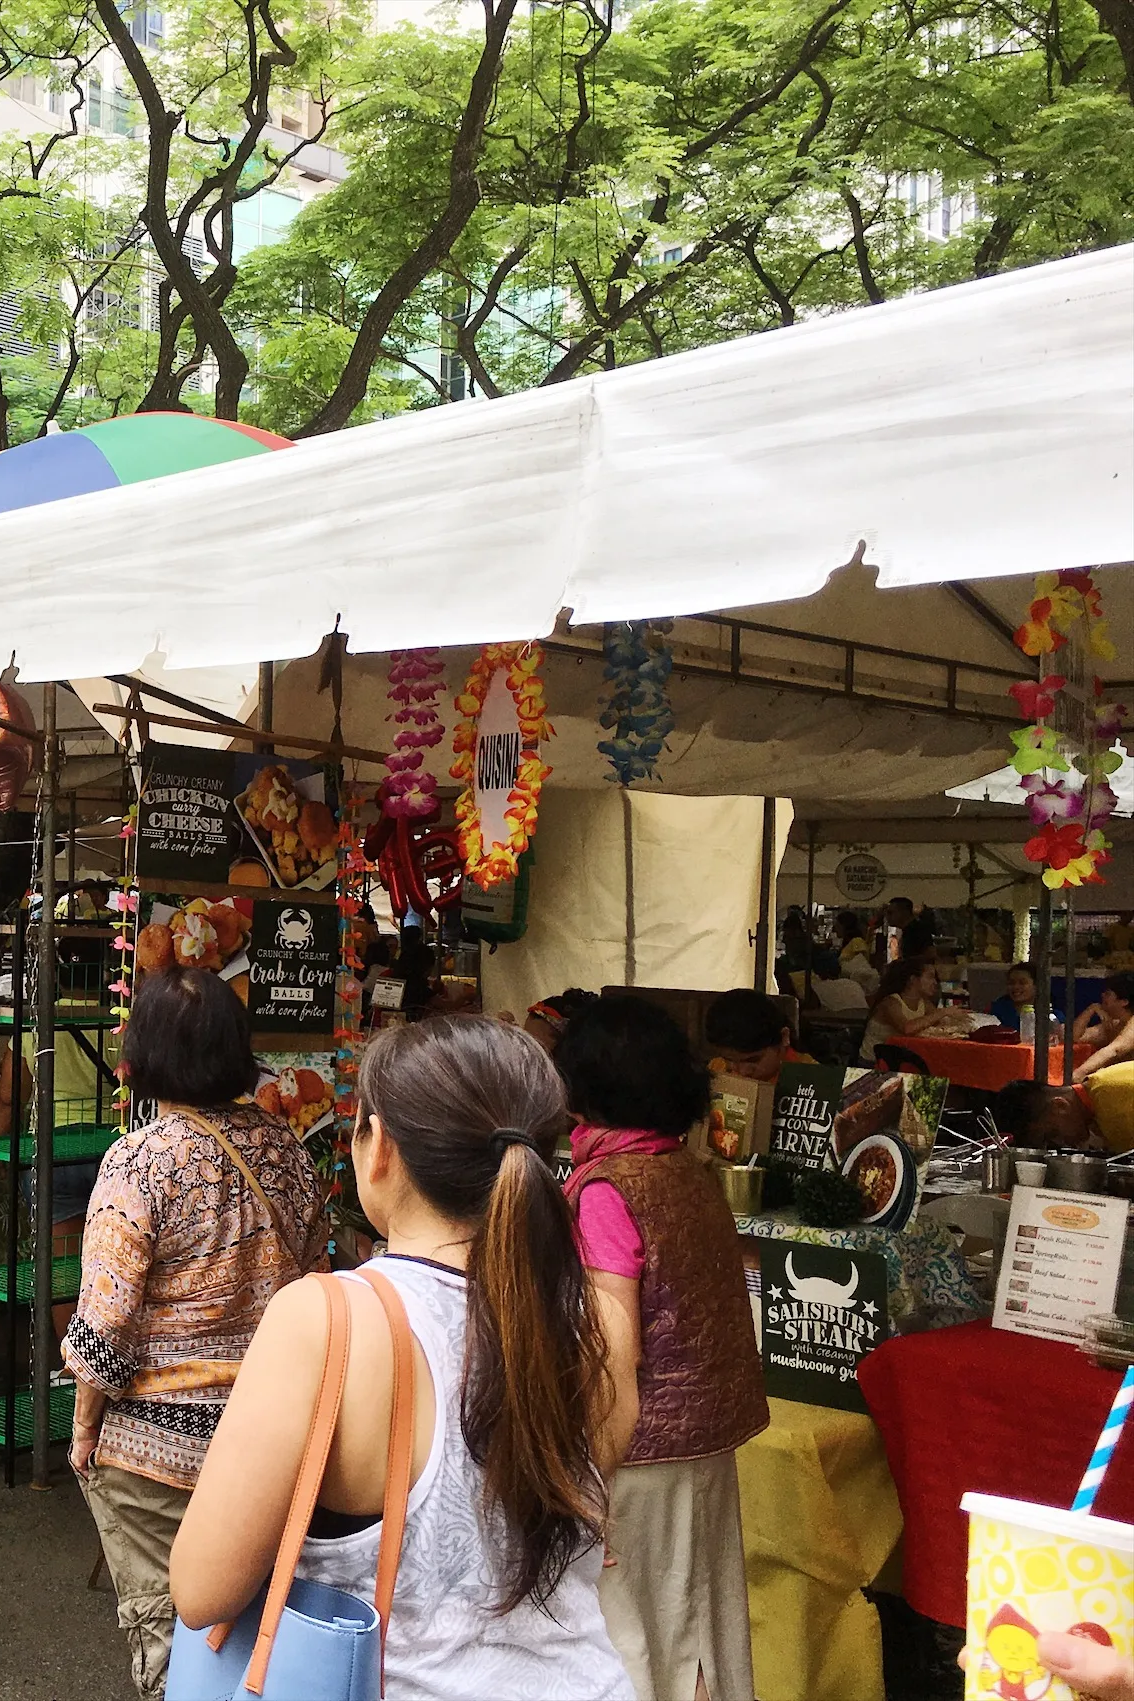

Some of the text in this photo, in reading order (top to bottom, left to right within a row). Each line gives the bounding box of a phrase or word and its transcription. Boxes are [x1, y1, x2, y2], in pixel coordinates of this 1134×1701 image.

[150, 772, 224, 791] CRUNCHY CREAMY
[142, 787, 230, 813] CHICKEN
[171, 802, 200, 816] curry
[148, 812, 223, 834] CHEESE
[168, 830, 203, 841] BALLS
[149, 838, 217, 858] with corn frites
[256, 948, 330, 961] CRUNCHY CREAMY
[249, 960, 336, 987] Crab & Corn
[273, 989, 310, 999] BALLS
[255, 1002, 328, 1022] with corn frites
[797, 1084, 815, 1099] beefy
[778, 1096, 829, 1120] CHILI
[786, 1117, 810, 1131] CON
[772, 1130, 827, 1158] ARNE
[767, 1301, 880, 1341] SALISBURY
[784, 1320, 863, 1354] STEAK
[770, 1351, 837, 1375] mushroom
[791, 1343, 856, 1366] with creamy
